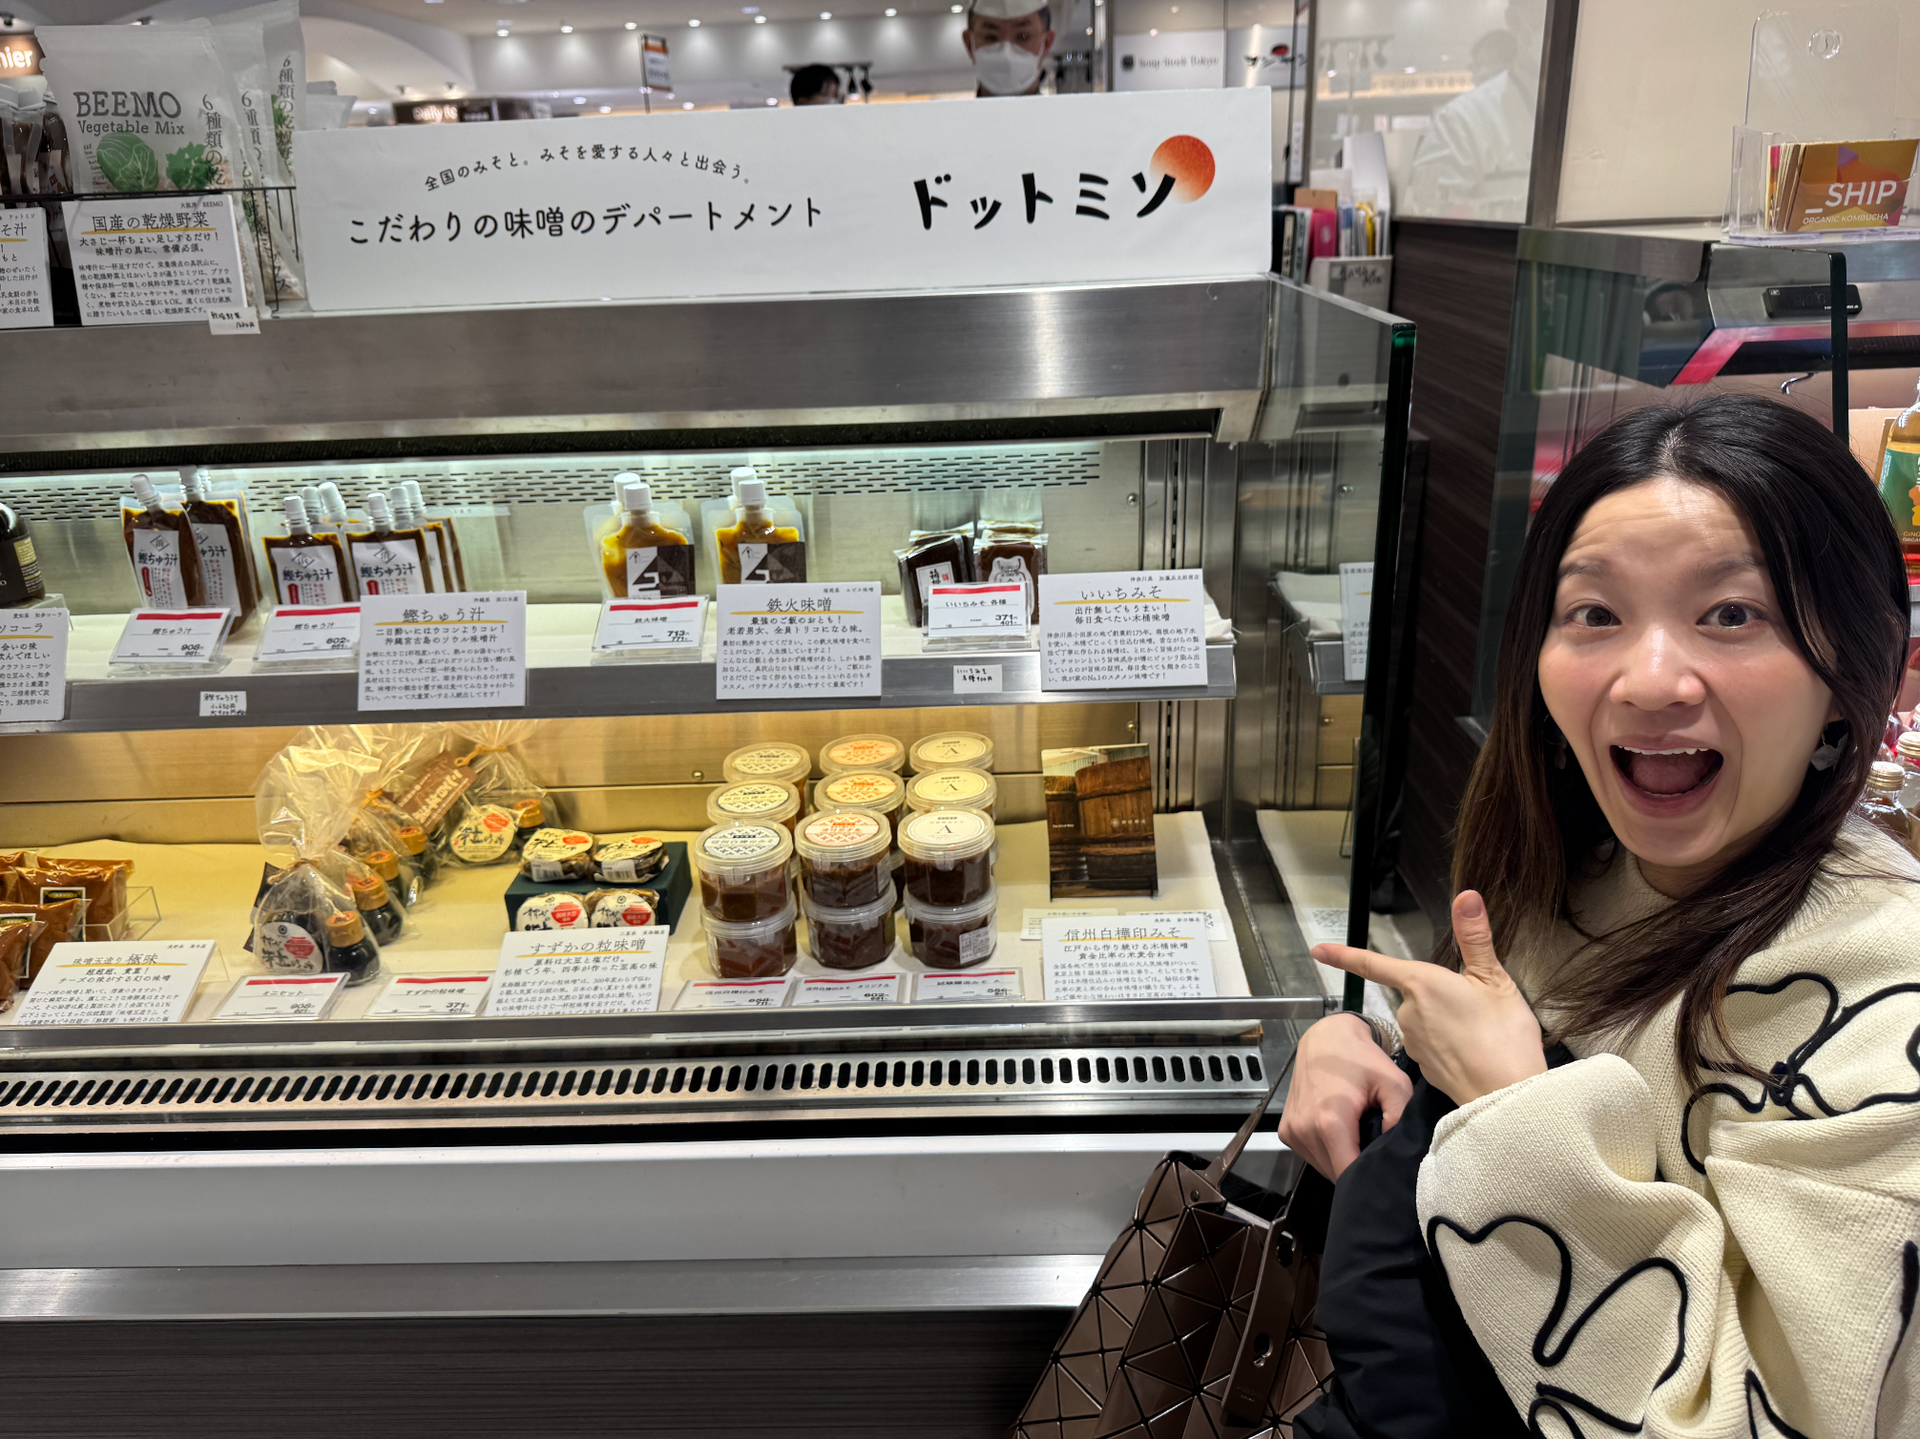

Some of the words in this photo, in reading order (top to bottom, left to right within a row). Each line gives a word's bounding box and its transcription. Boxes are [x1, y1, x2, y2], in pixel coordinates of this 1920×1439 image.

[73, 91, 181, 118] BEEMO
[78, 120, 149, 136] Vegetable
[154, 121, 185, 135] Mix
[424, 142, 750, 192] 全国のみそと。みそを愛する人々と出会う。
[913, 171, 1177, 230] ドットミソ
[1825, 180, 1897, 207] SHIP
[92, 211, 210, 231] 国産の乾燥野菜
[349, 197, 822, 245] こだわりの味噌のデパートメント
[1802, 215, 1840, 225] ORGANIC
[1841, 212, 1889, 223] KOMBUCHA
[79, 232, 219, 246] 大さじ一杯ちょい足しするだけ！
[95, 244, 204, 256] 味噌汁の具に、常備必須。
[138, 551, 179, 566] 鰹ちゅう汁
[282, 568, 334, 581] 鰹ちゅう汁
[360, 563, 417, 579] 鰹ちゅう汁
[1081, 585, 1162, 600] いいちみそ
[766, 597, 832, 613] 鉄火味噌
[1074, 603, 1167, 615] 出汁無しでもうまい！
[402, 606, 486, 623] 鰹ちゅう汁
[751, 615, 842, 625] 最強のご飯のおとも！
[1075, 613, 1170, 625] 毎日食べたい木桶味噌
[376, 625, 506, 637] 二日酔いにはウコンよりコレ！
[726, 624, 864, 636] 老若男女、全員トリコになる味。
[385, 635, 498, 646] 沖縄宮古島のソウル味噌汁
[1064, 926, 1181, 941] 信州白樺印みそ
[530, 938, 647, 955] すずかの粒味噌
[1064, 942, 1188, 952] 江戸から作り続ける木桶味噌
[125, 952, 159, 965] 極味
[534, 956, 626, 967] 原料は大豆と塩だけ。
[58, 974, 171, 985] チーズの味がする幻の味噌
